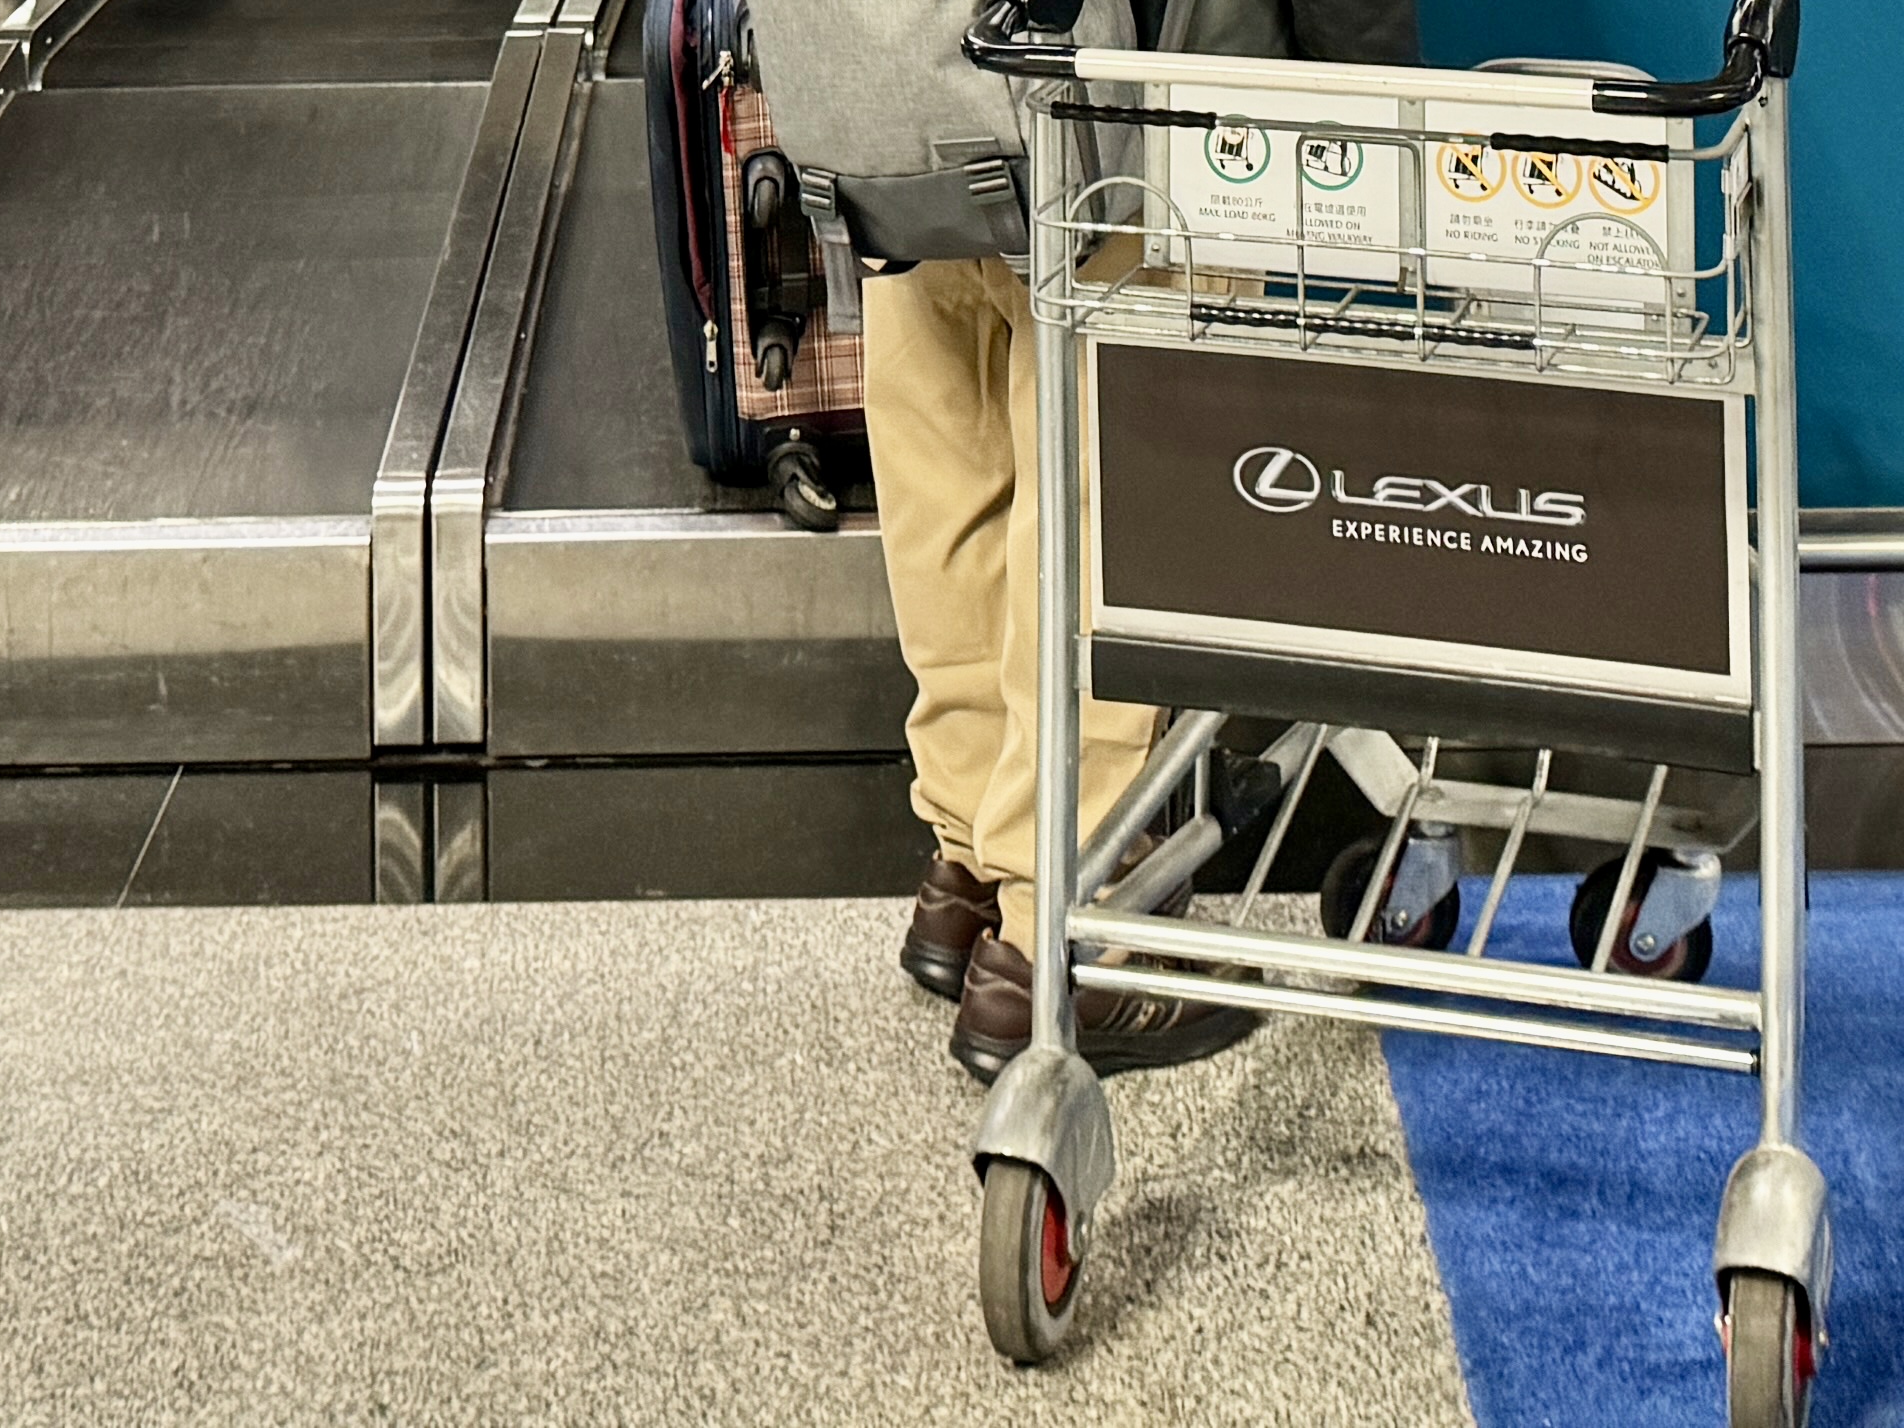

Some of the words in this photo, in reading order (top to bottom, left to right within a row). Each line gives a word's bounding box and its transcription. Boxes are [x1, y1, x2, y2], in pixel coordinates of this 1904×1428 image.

[1445, 229, 1461, 240] NO
[1514, 235, 1530, 246] NO
[1331, 469, 1588, 527] LEXUS
[1332, 519, 1473, 551] EXPERIENCE
[1480, 534, 1589, 564] AMAZING
